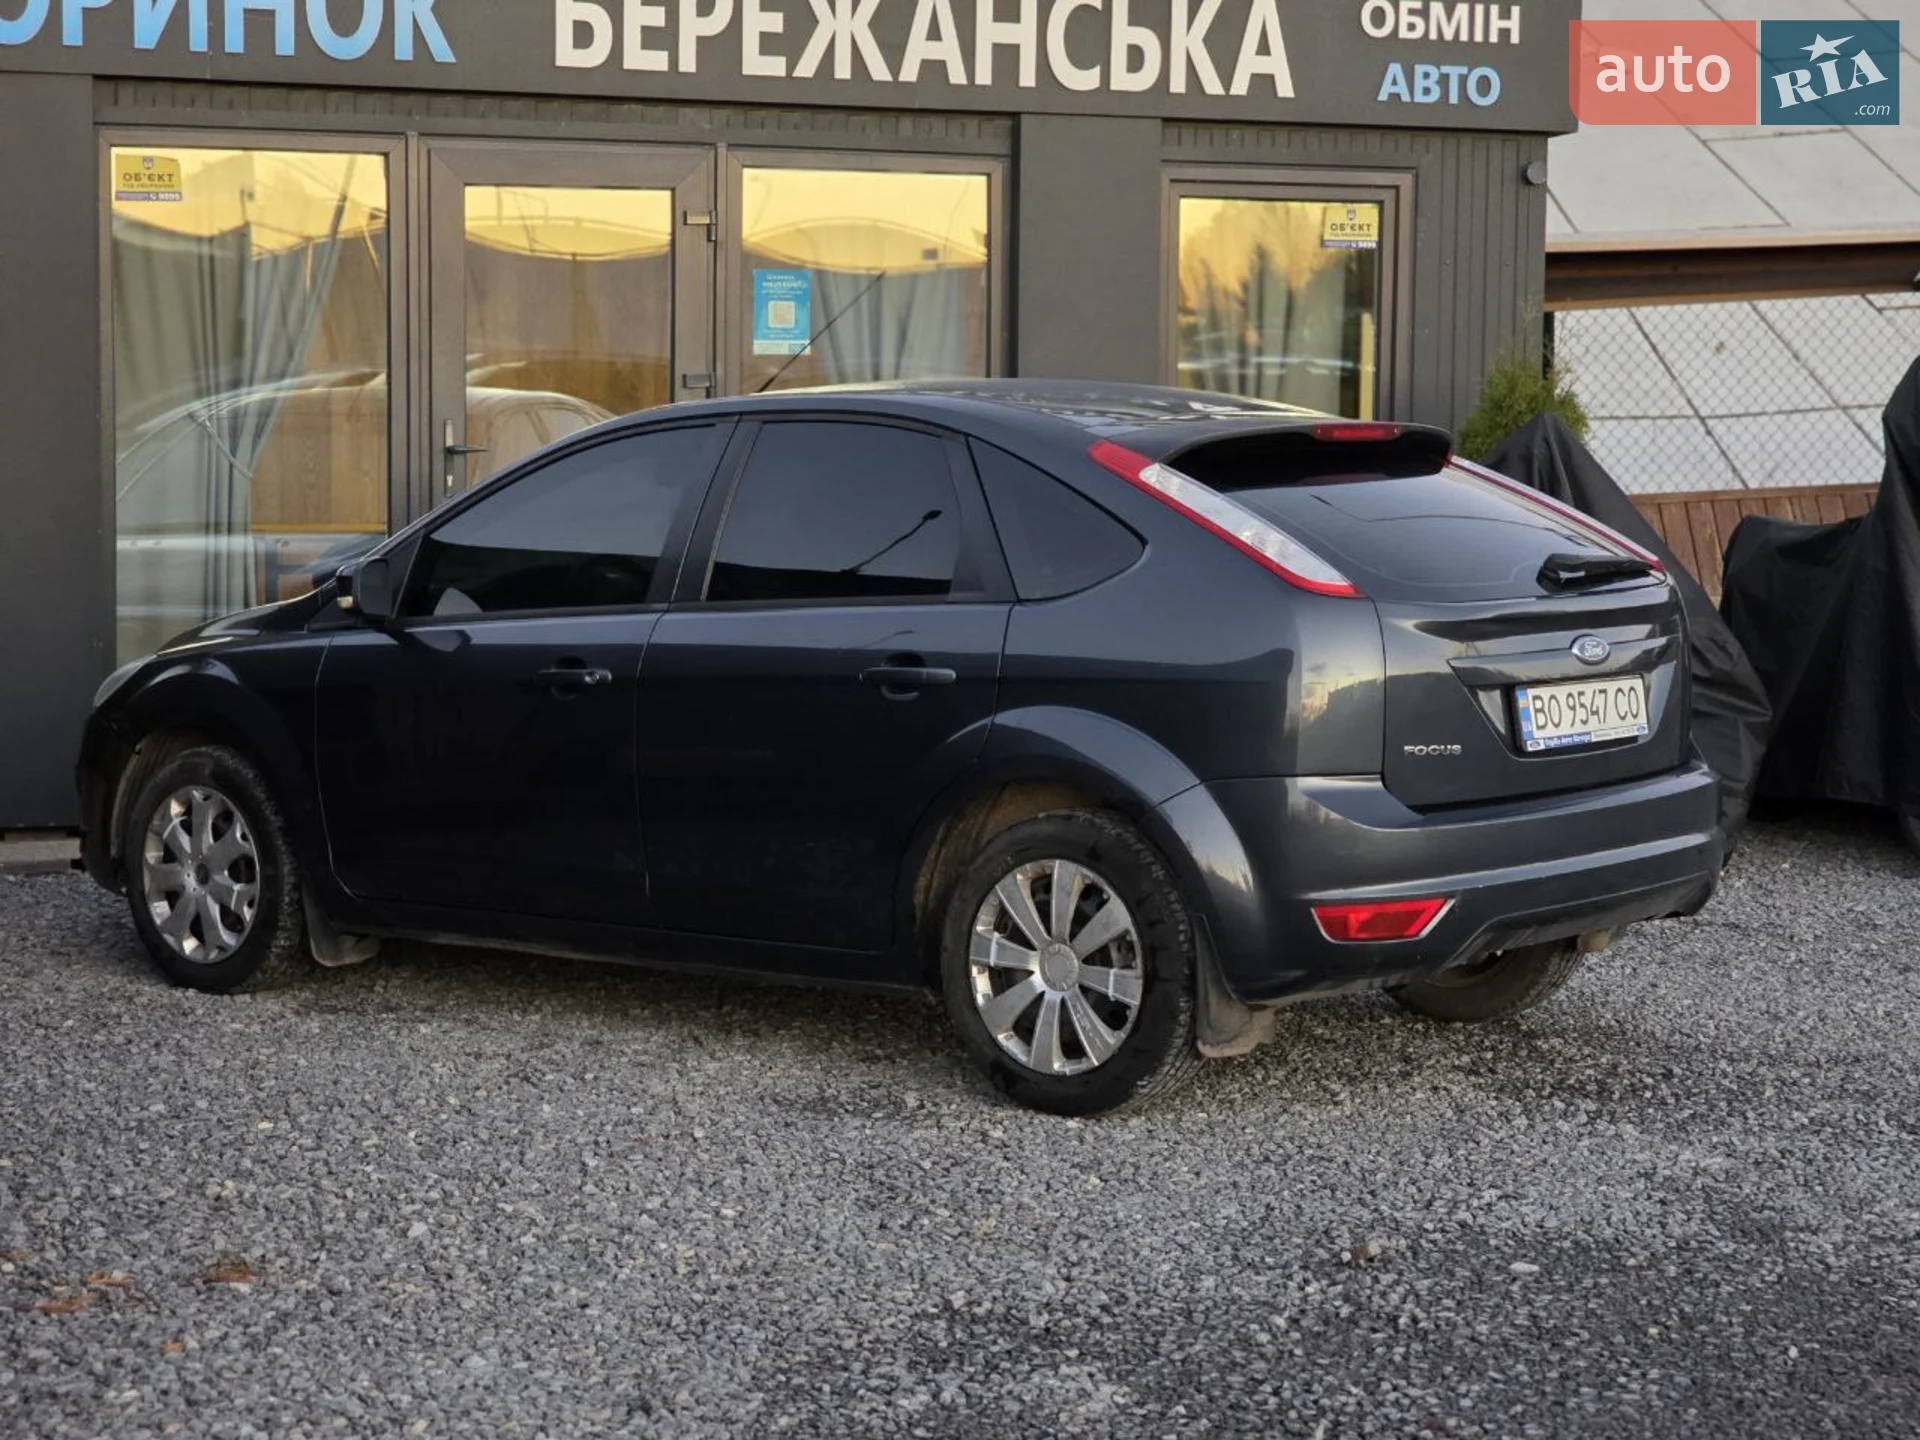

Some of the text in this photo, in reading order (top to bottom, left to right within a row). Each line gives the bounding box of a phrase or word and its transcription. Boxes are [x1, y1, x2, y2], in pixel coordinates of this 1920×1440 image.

[1360, 0, 1520, 44] ОБМІН
[554, 0, 1295, 97] БЕРЕЖАНСЬКА
[1377, 62, 1501, 106] АВТО
[1532, 686, 1640, 730] BO 9547 CO
[1403, 745, 1462, 756] FOCUS
